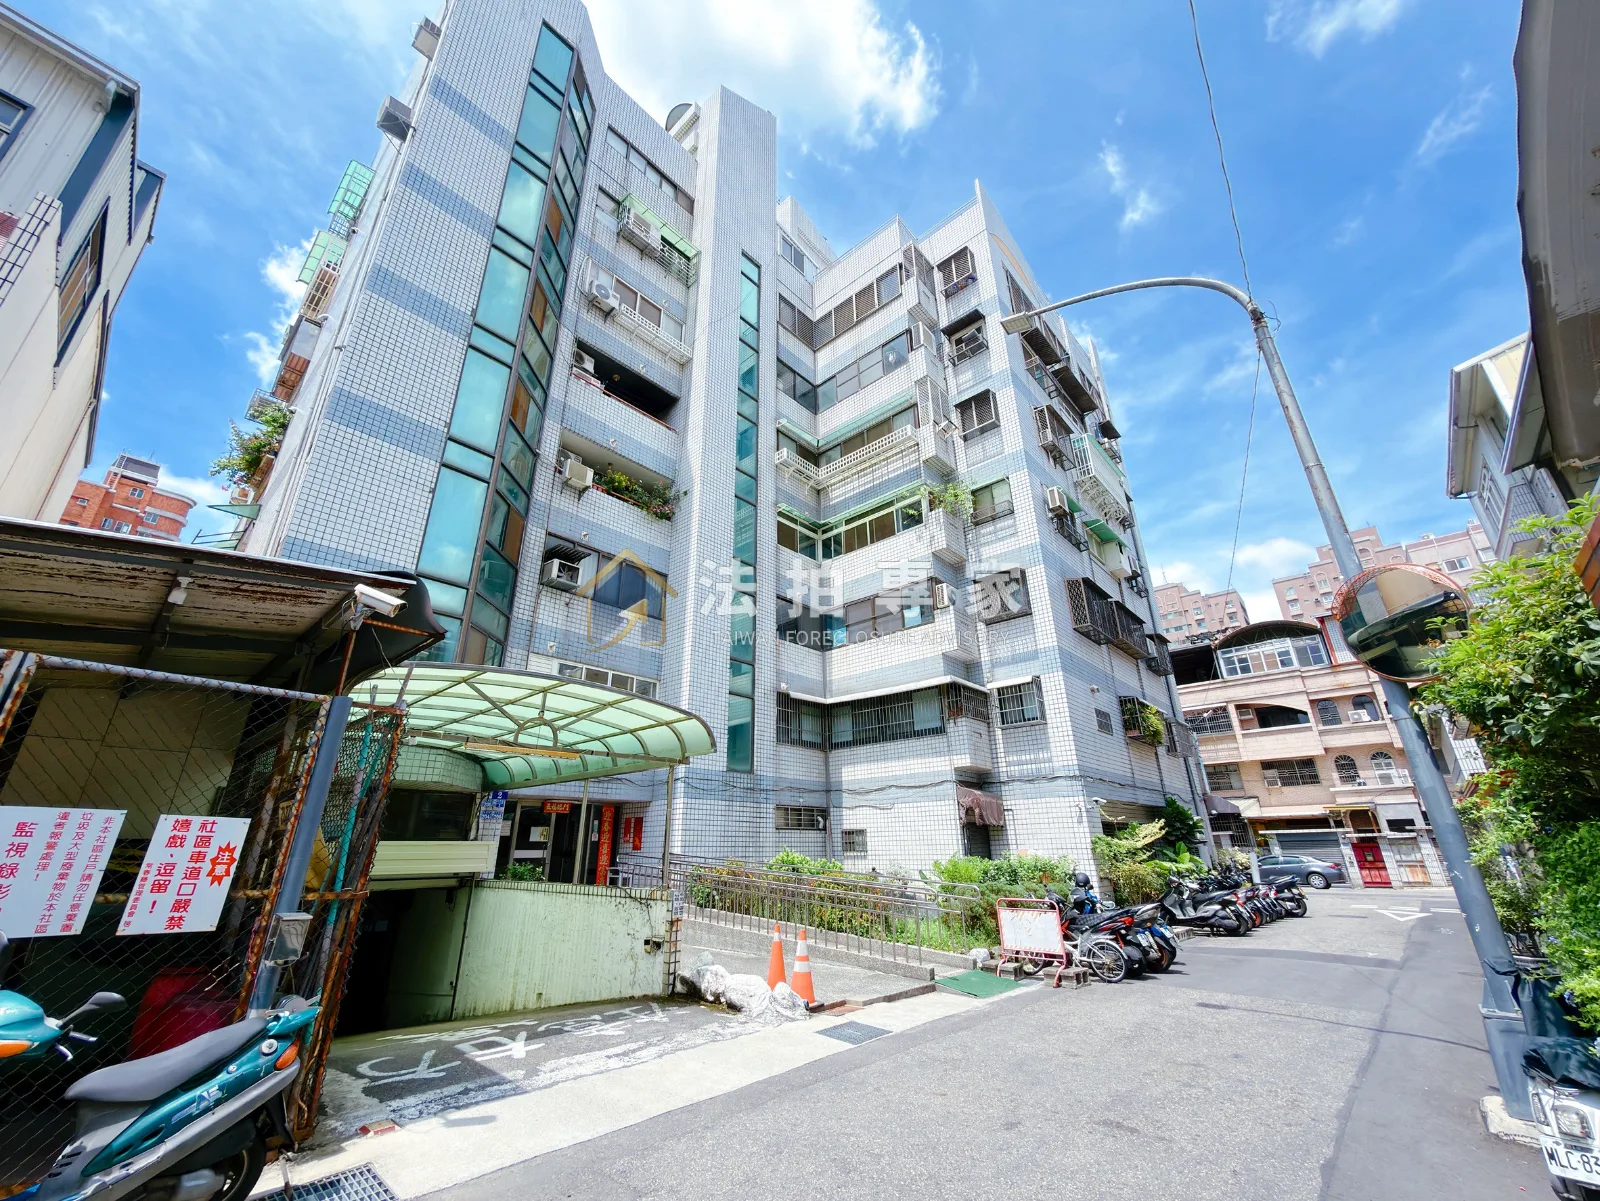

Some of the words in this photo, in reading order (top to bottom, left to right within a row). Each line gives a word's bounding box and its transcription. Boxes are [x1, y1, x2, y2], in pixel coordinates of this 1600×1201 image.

[34, 812, 94, 934] 垃圾及大型廢棄物於本社區
[164, 819, 218, 930] 社區車道口嚴禁
[212, 851, 230, 876] 注意
